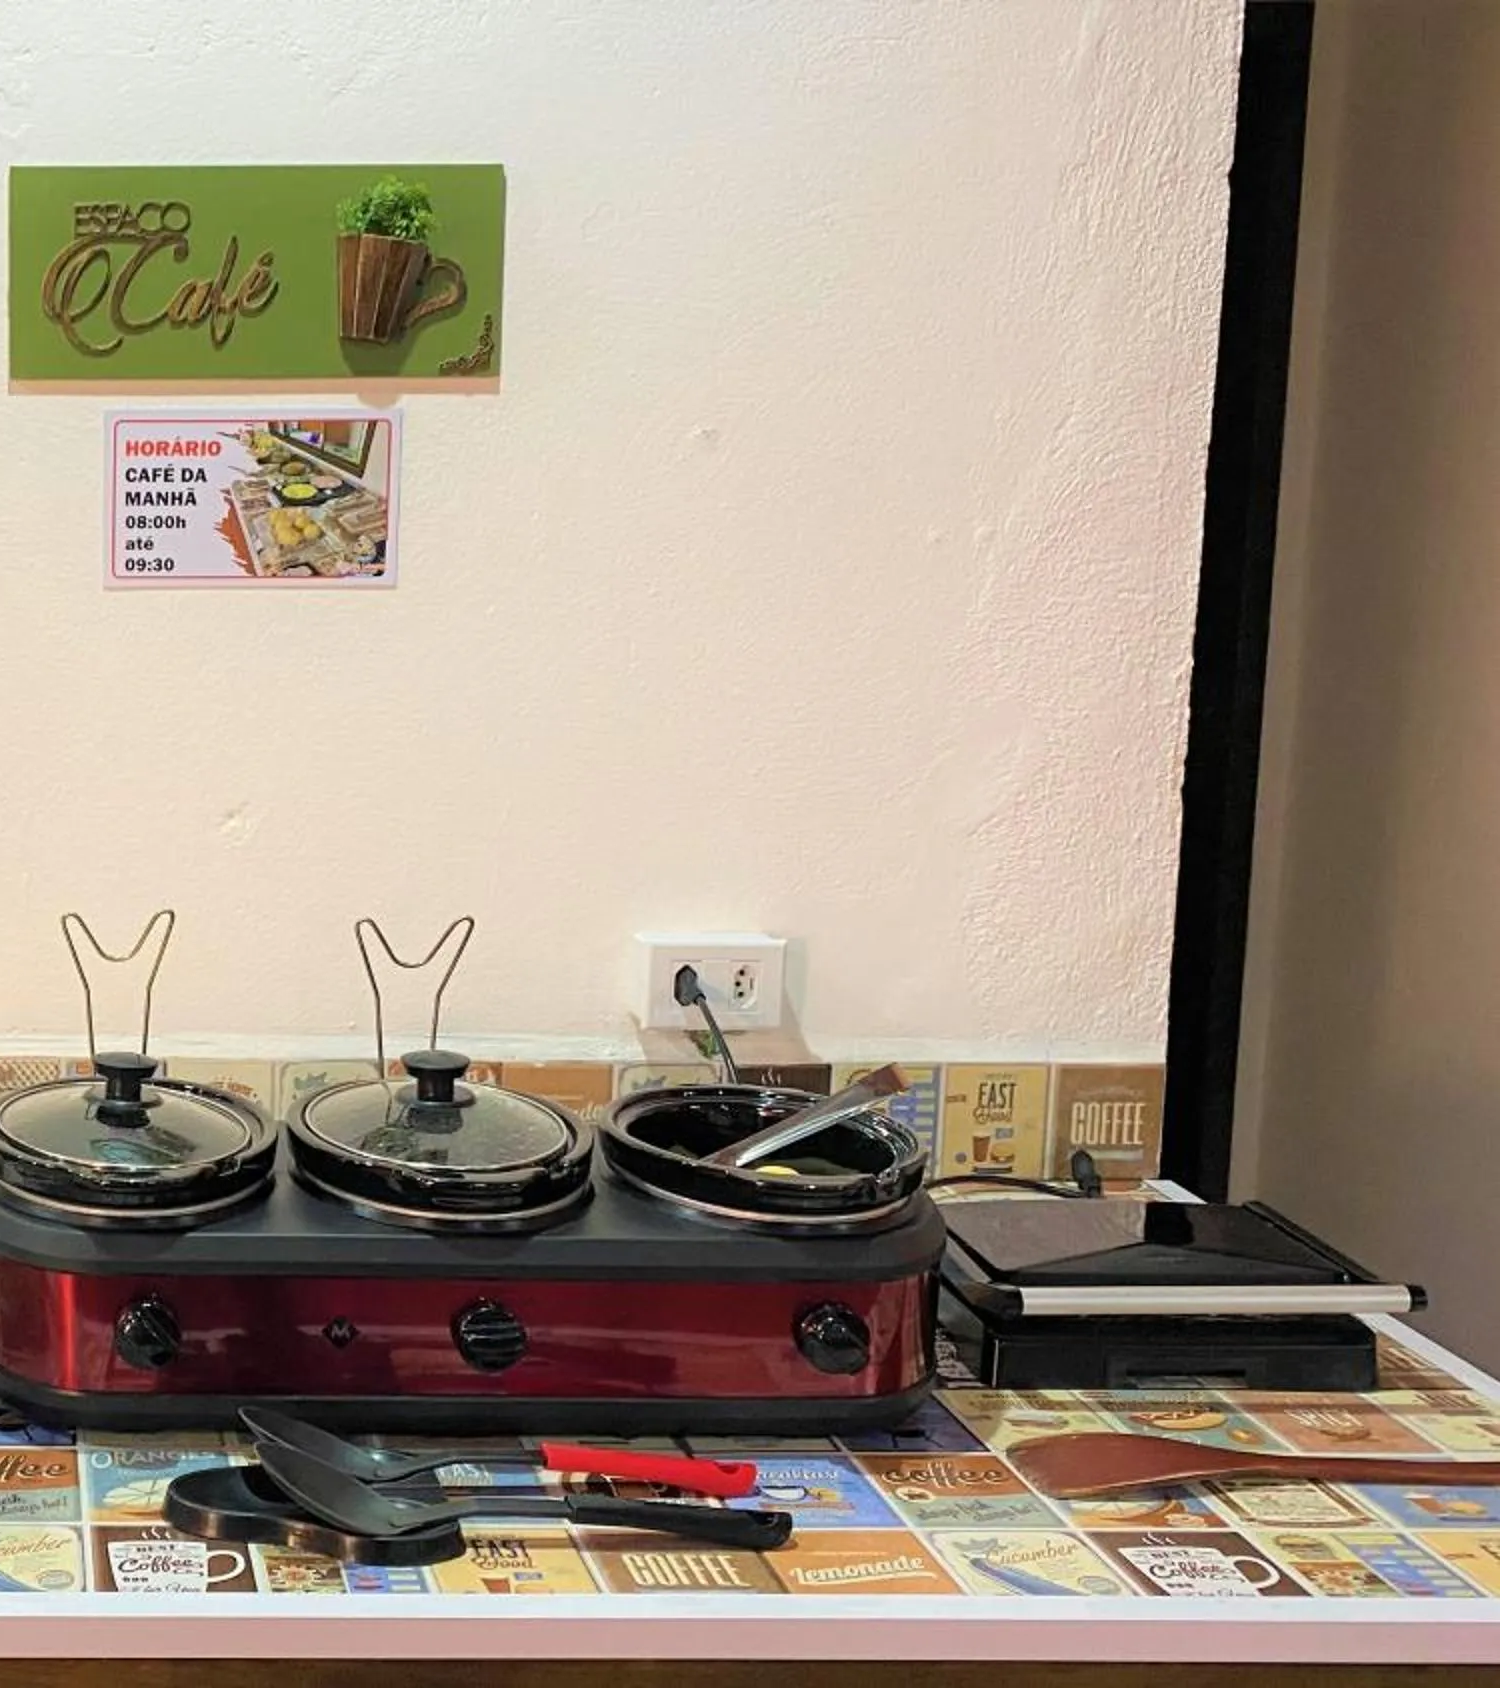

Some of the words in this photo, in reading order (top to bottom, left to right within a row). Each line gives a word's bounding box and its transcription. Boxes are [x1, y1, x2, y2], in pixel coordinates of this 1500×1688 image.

[124, 436, 222, 457] HORÁRIO
[125, 463, 175, 483] CAFÉ
[181, 467, 208, 483] DA
[125, 487, 197, 507] MANHÃ
[125, 515, 187, 529] 08:00h
[125, 536, 154, 551] até
[125, 558, 175, 572] 09:30
[1070, 1101, 1147, 1146] COFFEE
[881, 1461, 1008, 1488] coffee
[986, 1539, 1079, 1566] Cucumber
[621, 1552, 751, 1588] COFFEE
[790, 1554, 930, 1586] Lemonade
